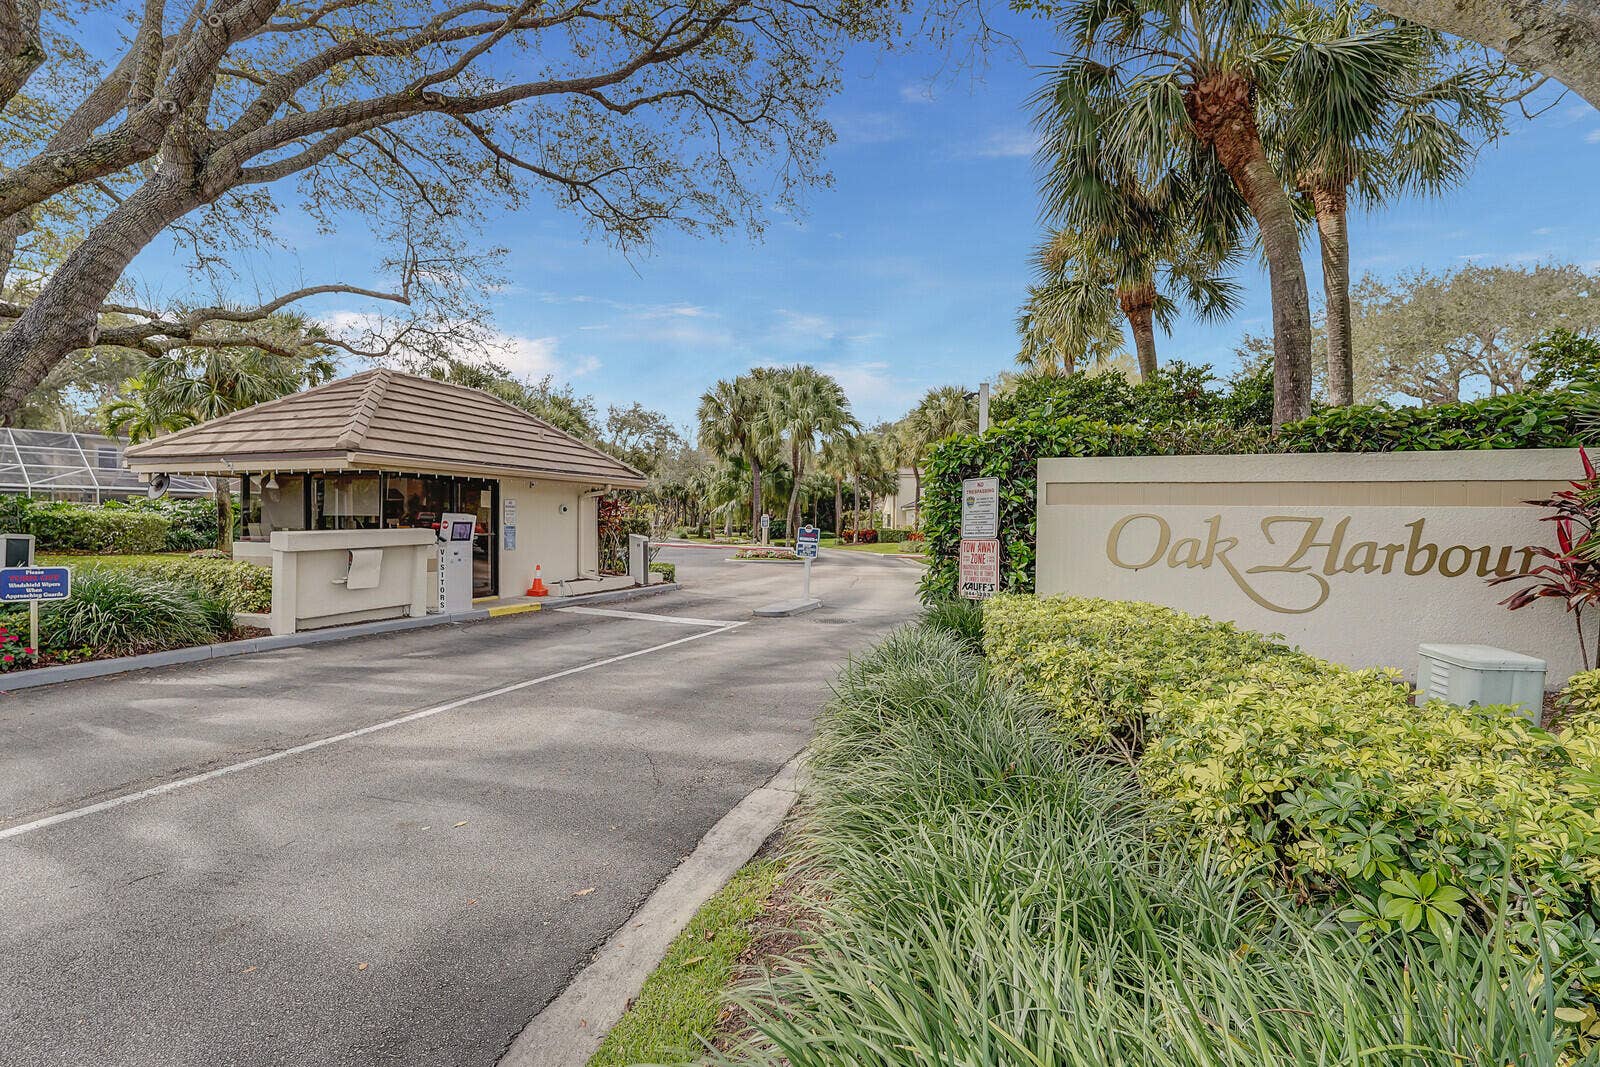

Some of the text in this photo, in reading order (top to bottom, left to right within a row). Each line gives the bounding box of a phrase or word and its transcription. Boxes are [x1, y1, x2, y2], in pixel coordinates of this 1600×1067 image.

[963, 541, 996, 553] TOW AWAY
[1246, 515, 1536, 578] Harbour
[970, 553, 986, 565] ZONE
[962, 582, 996, 592] KAUFF'S
